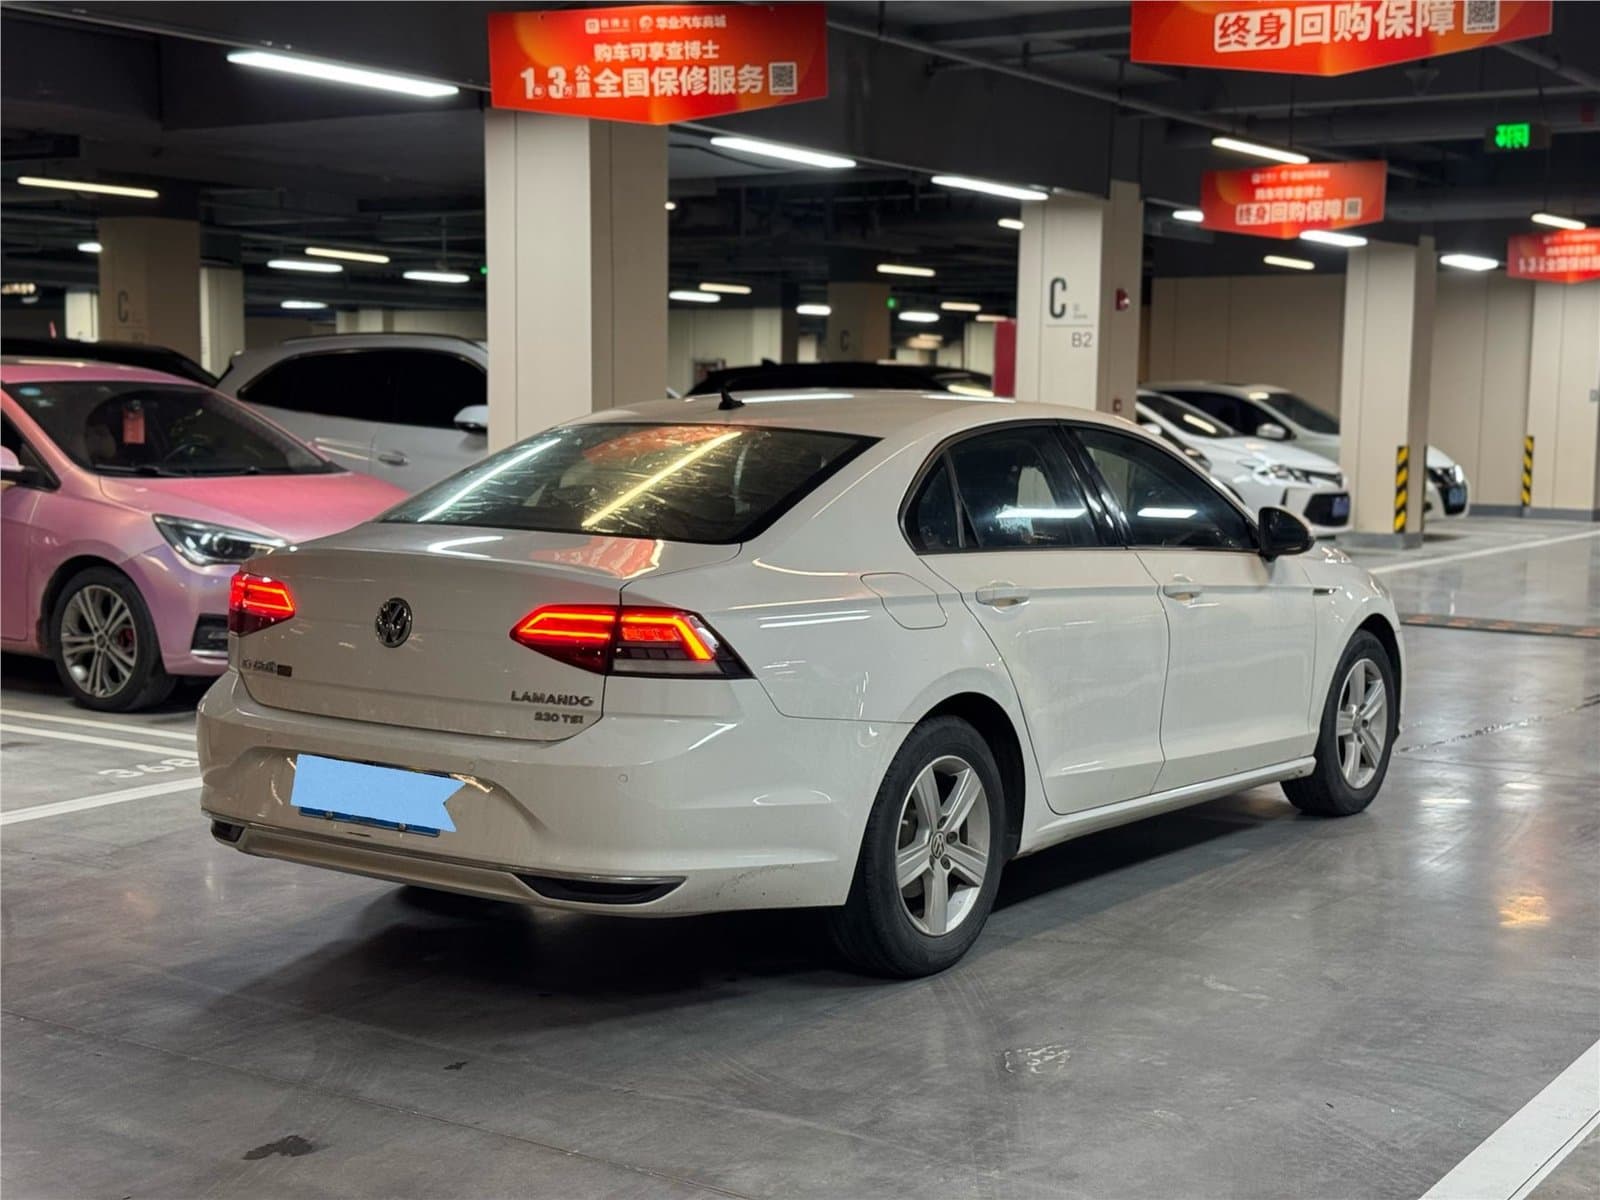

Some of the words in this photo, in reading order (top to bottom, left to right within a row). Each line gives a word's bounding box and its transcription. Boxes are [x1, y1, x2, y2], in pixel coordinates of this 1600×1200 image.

[594, 41, 719, 62] 购车可享查博士
[118, 290, 128, 323] C
[1050, 277, 1067, 319] C
[1072, 332, 1093, 348] B2
